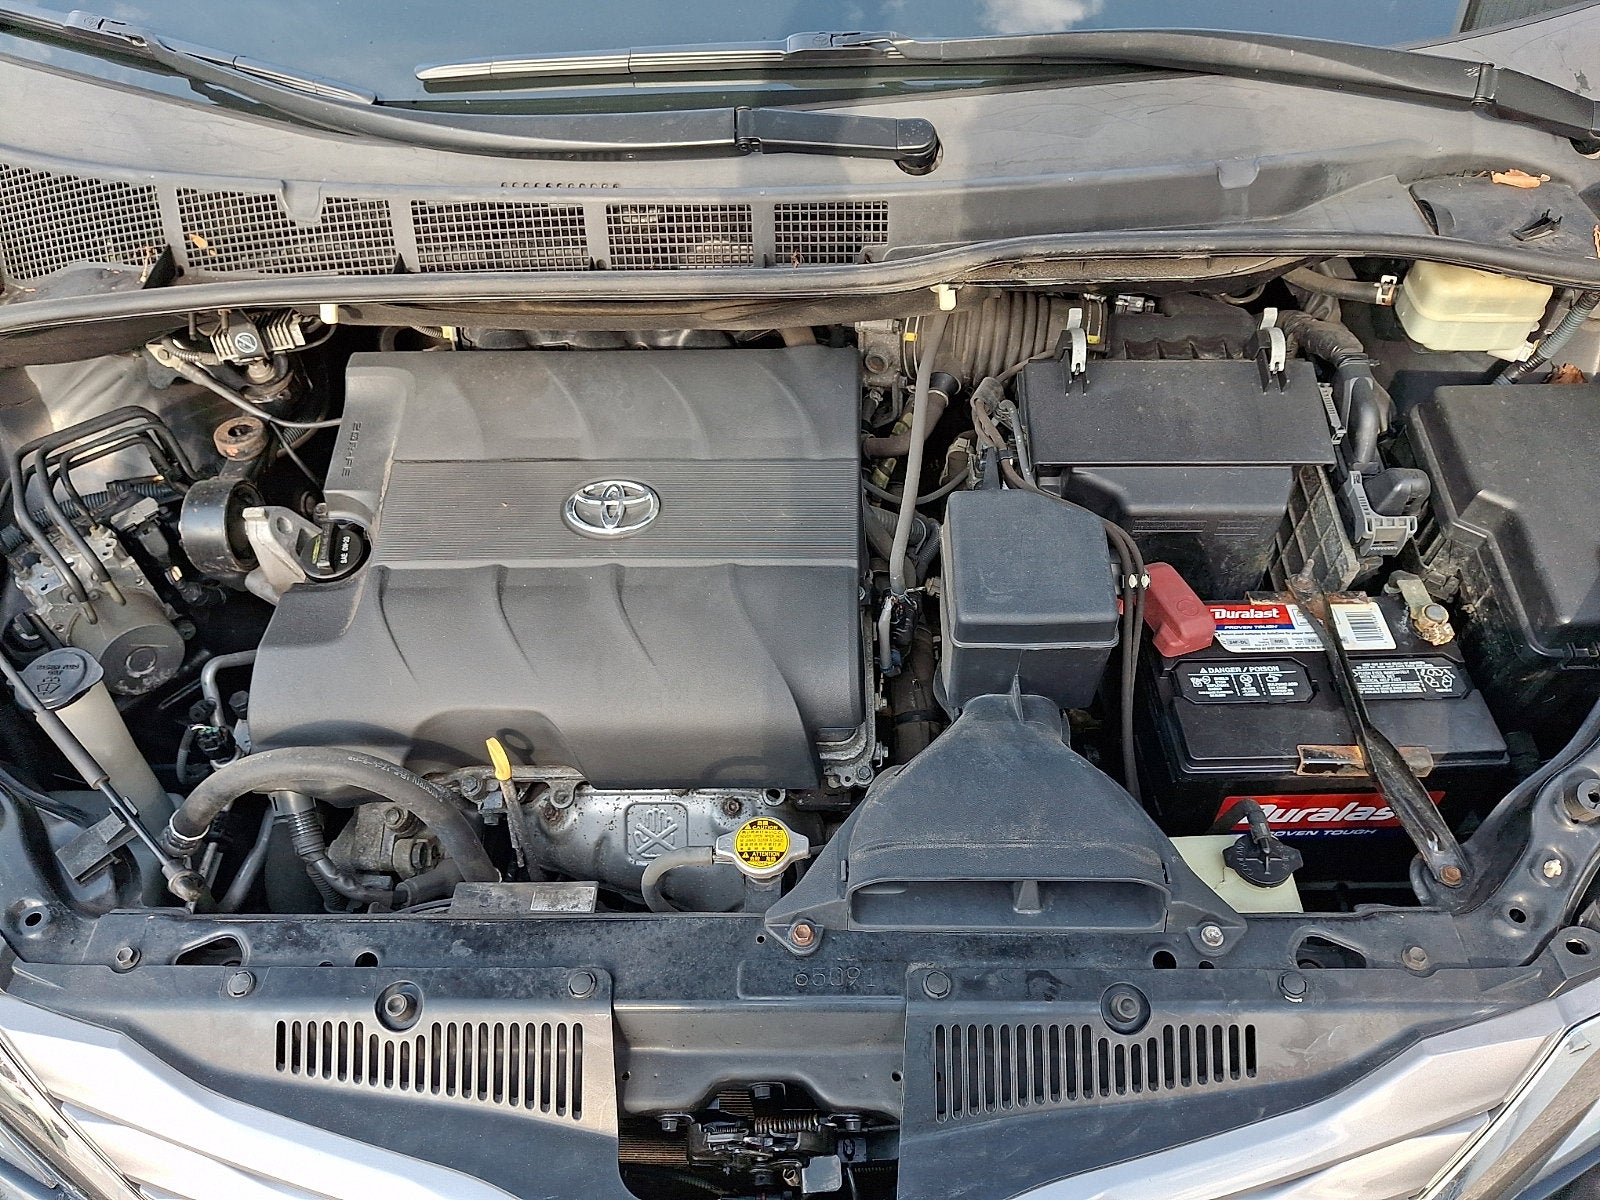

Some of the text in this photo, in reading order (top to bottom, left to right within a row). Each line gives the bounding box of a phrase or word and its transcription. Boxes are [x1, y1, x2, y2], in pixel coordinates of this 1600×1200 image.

[340, 552, 348, 564] SAE
[1210, 608, 1280, 619] Duralast
[1238, 801, 1398, 824] uralas
